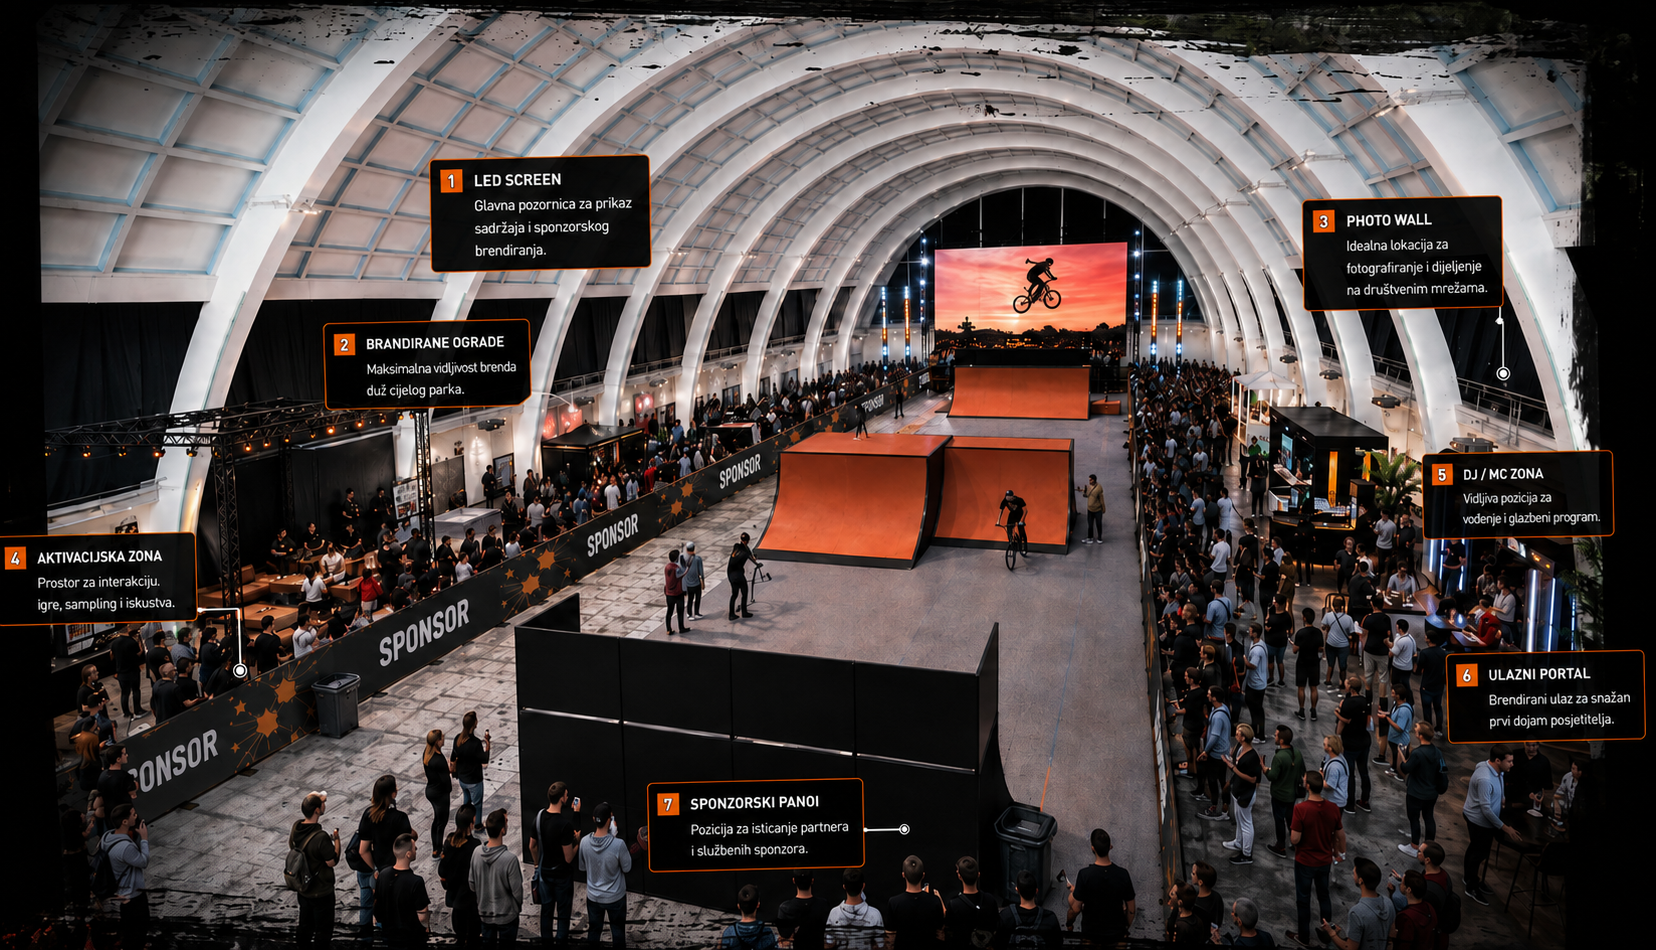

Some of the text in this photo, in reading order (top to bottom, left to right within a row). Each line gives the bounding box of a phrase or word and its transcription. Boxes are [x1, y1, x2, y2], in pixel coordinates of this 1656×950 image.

[719, 453, 761, 490] SPONSOR
[587, 513, 638, 558] SPONSOR
[379, 598, 470, 667] SPONSOR
[128, 729, 218, 792] ONSOR
